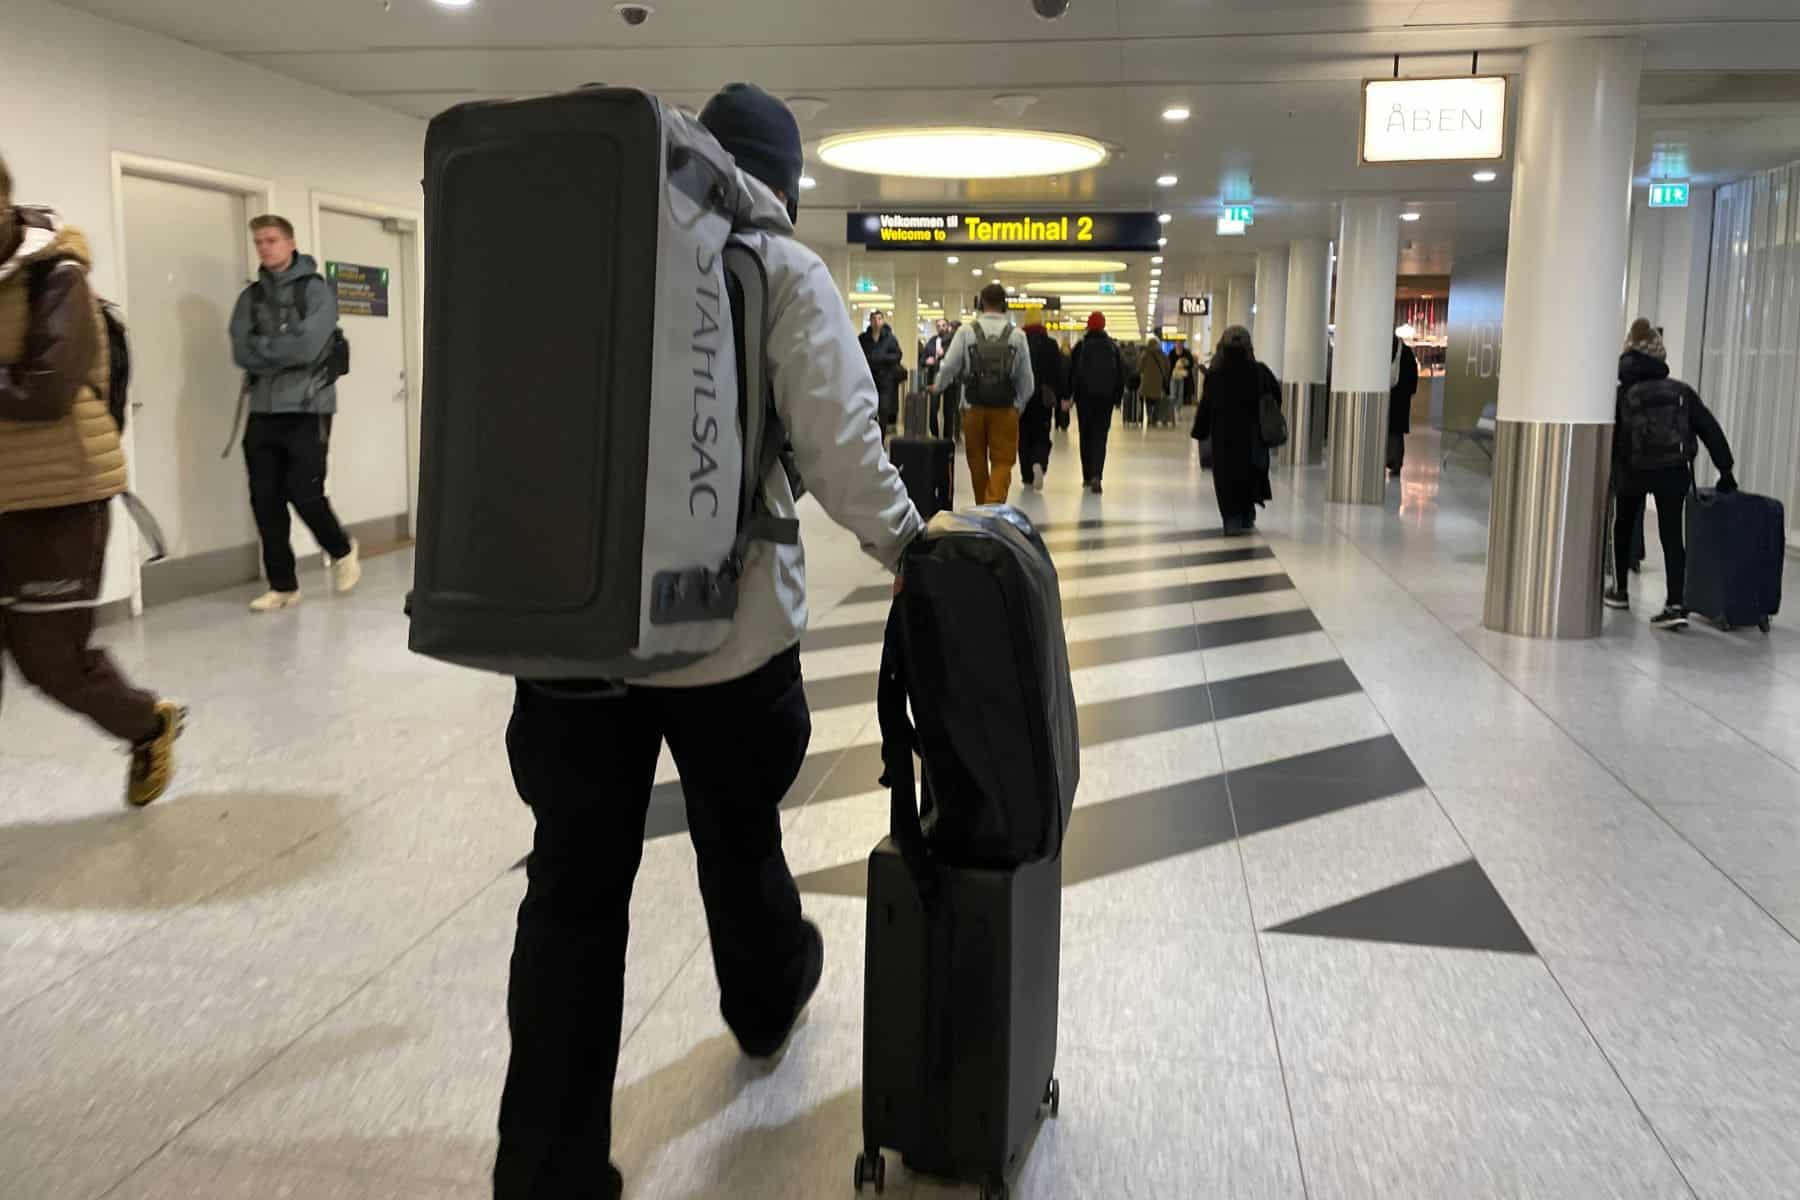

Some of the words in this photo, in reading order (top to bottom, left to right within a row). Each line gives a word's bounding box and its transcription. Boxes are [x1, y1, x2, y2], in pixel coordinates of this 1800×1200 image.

[1386, 103, 1483, 132] ÅBEN
[880, 214, 944, 228] Velkommen
[946, 215, 958, 228] til
[964, 216, 1068, 241] Terminal
[1077, 216, 1093, 241] 2
[881, 228, 931, 241] Welcome
[933, 228, 946, 241] to
[688, 244, 721, 518] STAHLSAC
